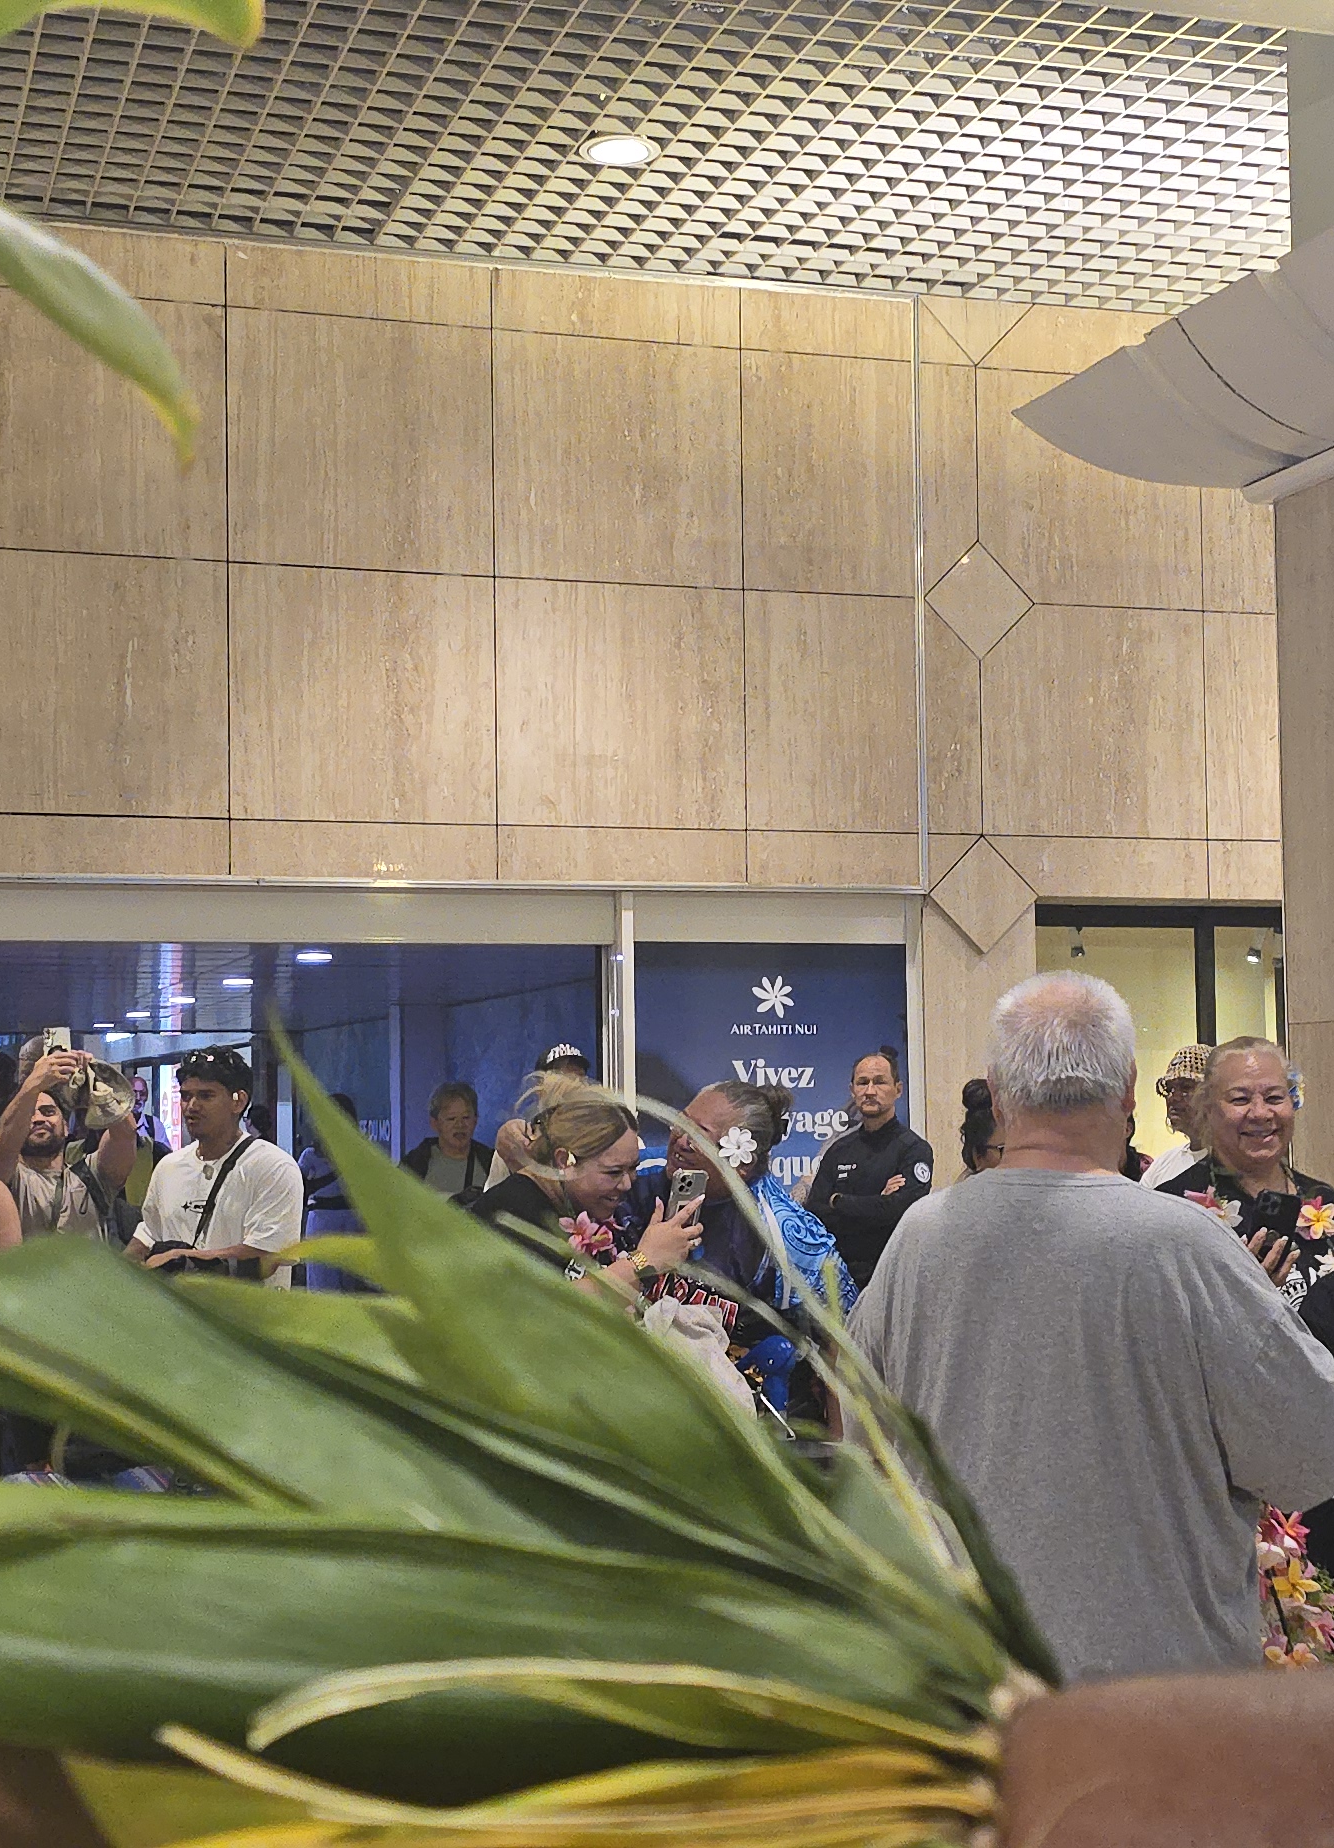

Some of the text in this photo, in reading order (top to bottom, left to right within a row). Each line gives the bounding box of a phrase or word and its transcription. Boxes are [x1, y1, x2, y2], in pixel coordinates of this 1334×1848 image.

[730, 1024, 818, 1036] AIR TAHITI NUI
[732, 1058, 815, 1089] Vivez
